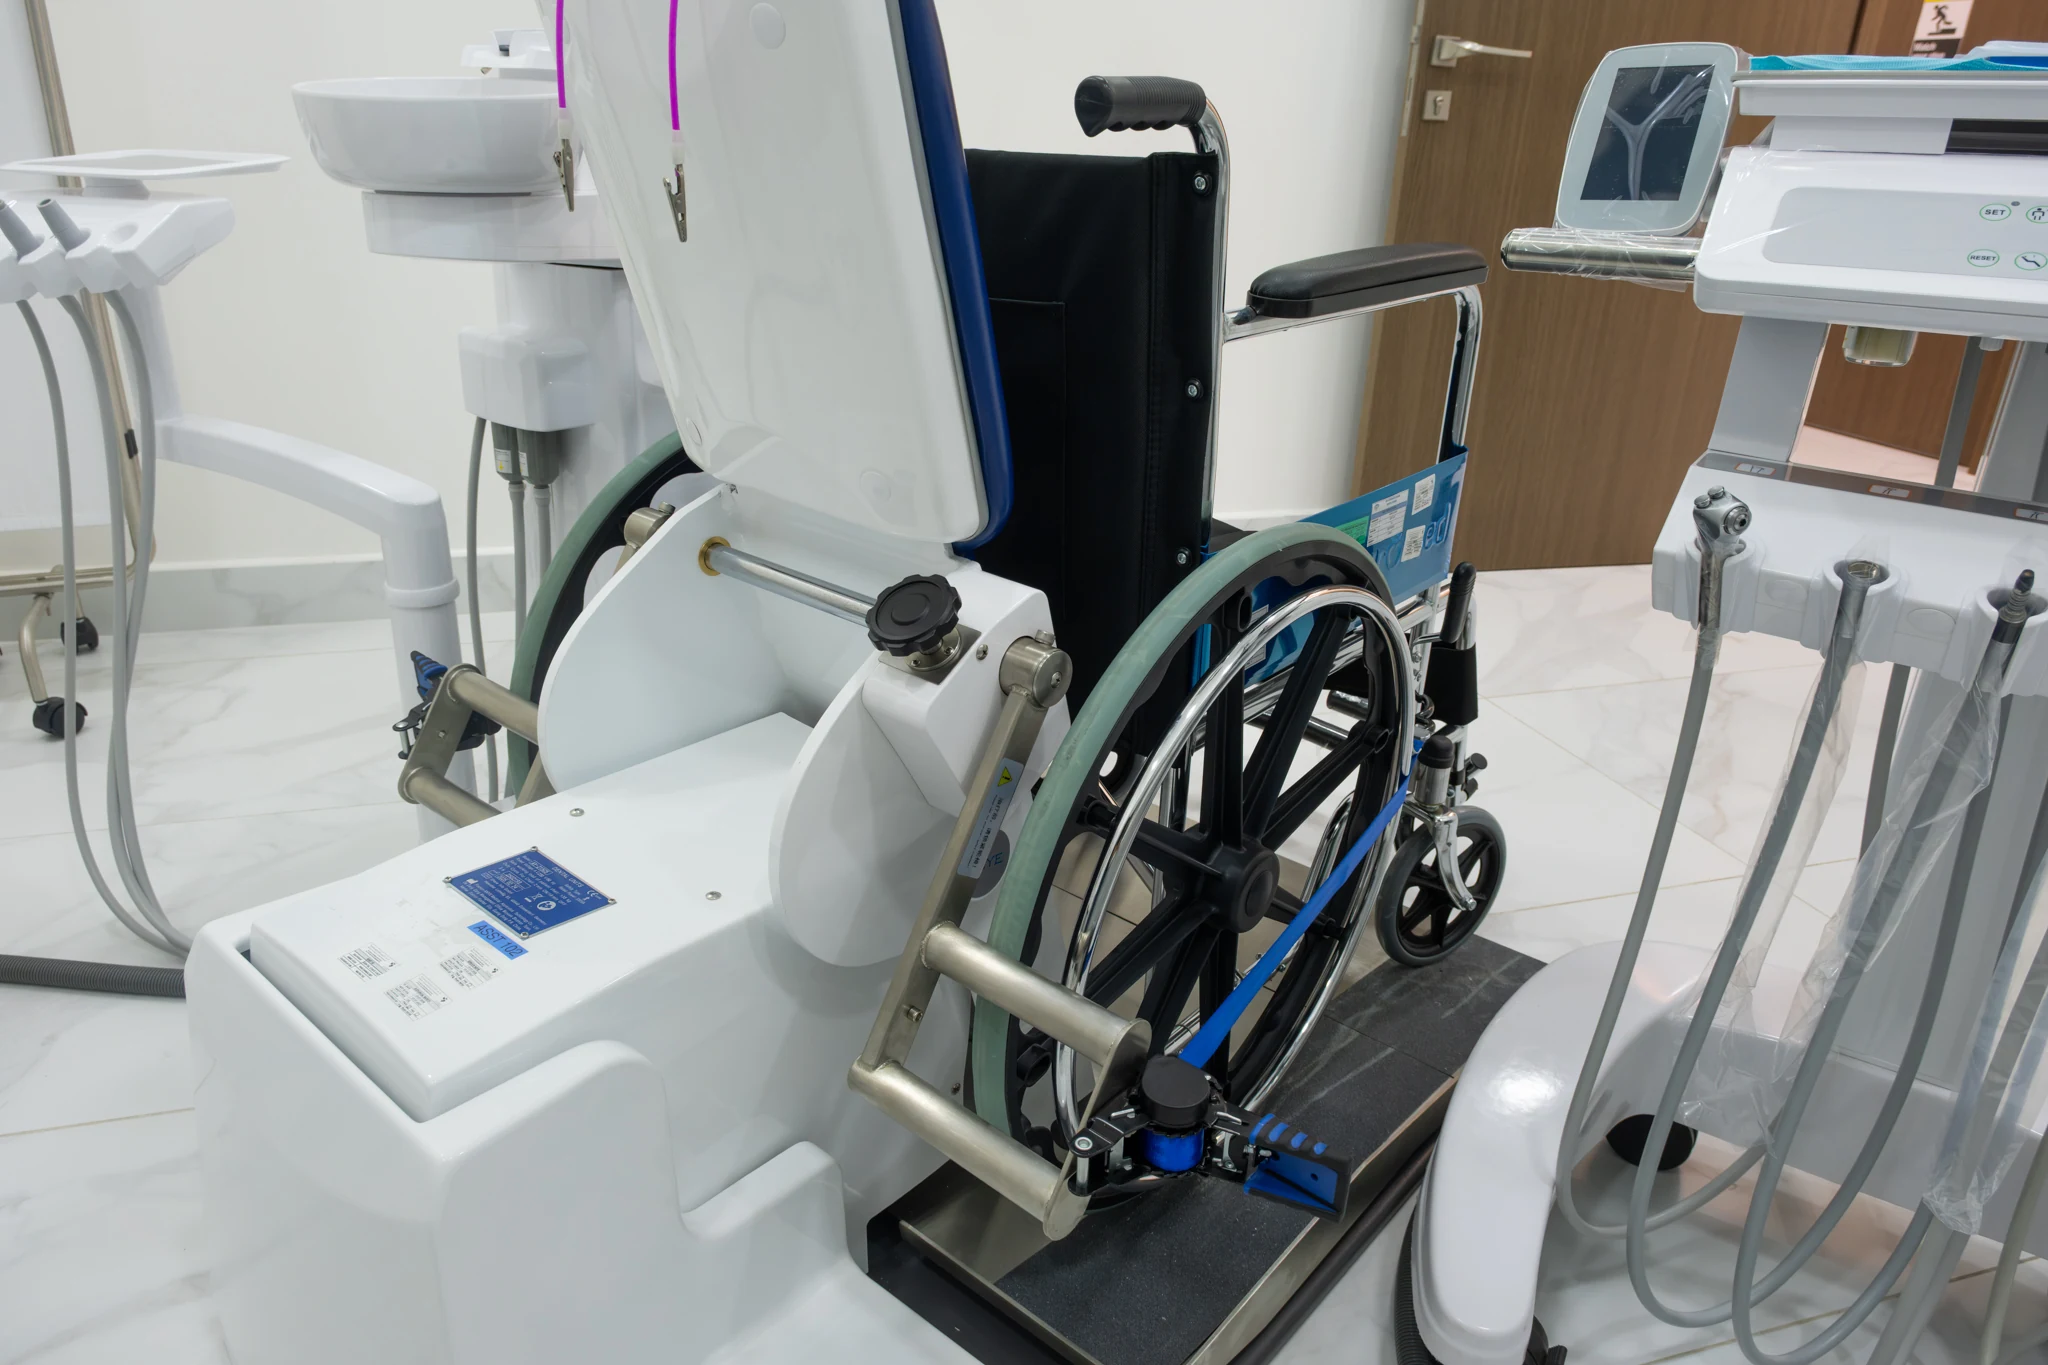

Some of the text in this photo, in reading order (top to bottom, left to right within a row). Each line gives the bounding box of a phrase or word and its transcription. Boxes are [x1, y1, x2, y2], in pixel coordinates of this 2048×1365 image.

[1984, 208, 2006, 216] SET
[1970, 254, 1997, 262] RESET
[551, 866, 570, 879] DENTAL
[568, 877, 585, 888] UNITS
[473, 924, 523, 957] ASST 102
